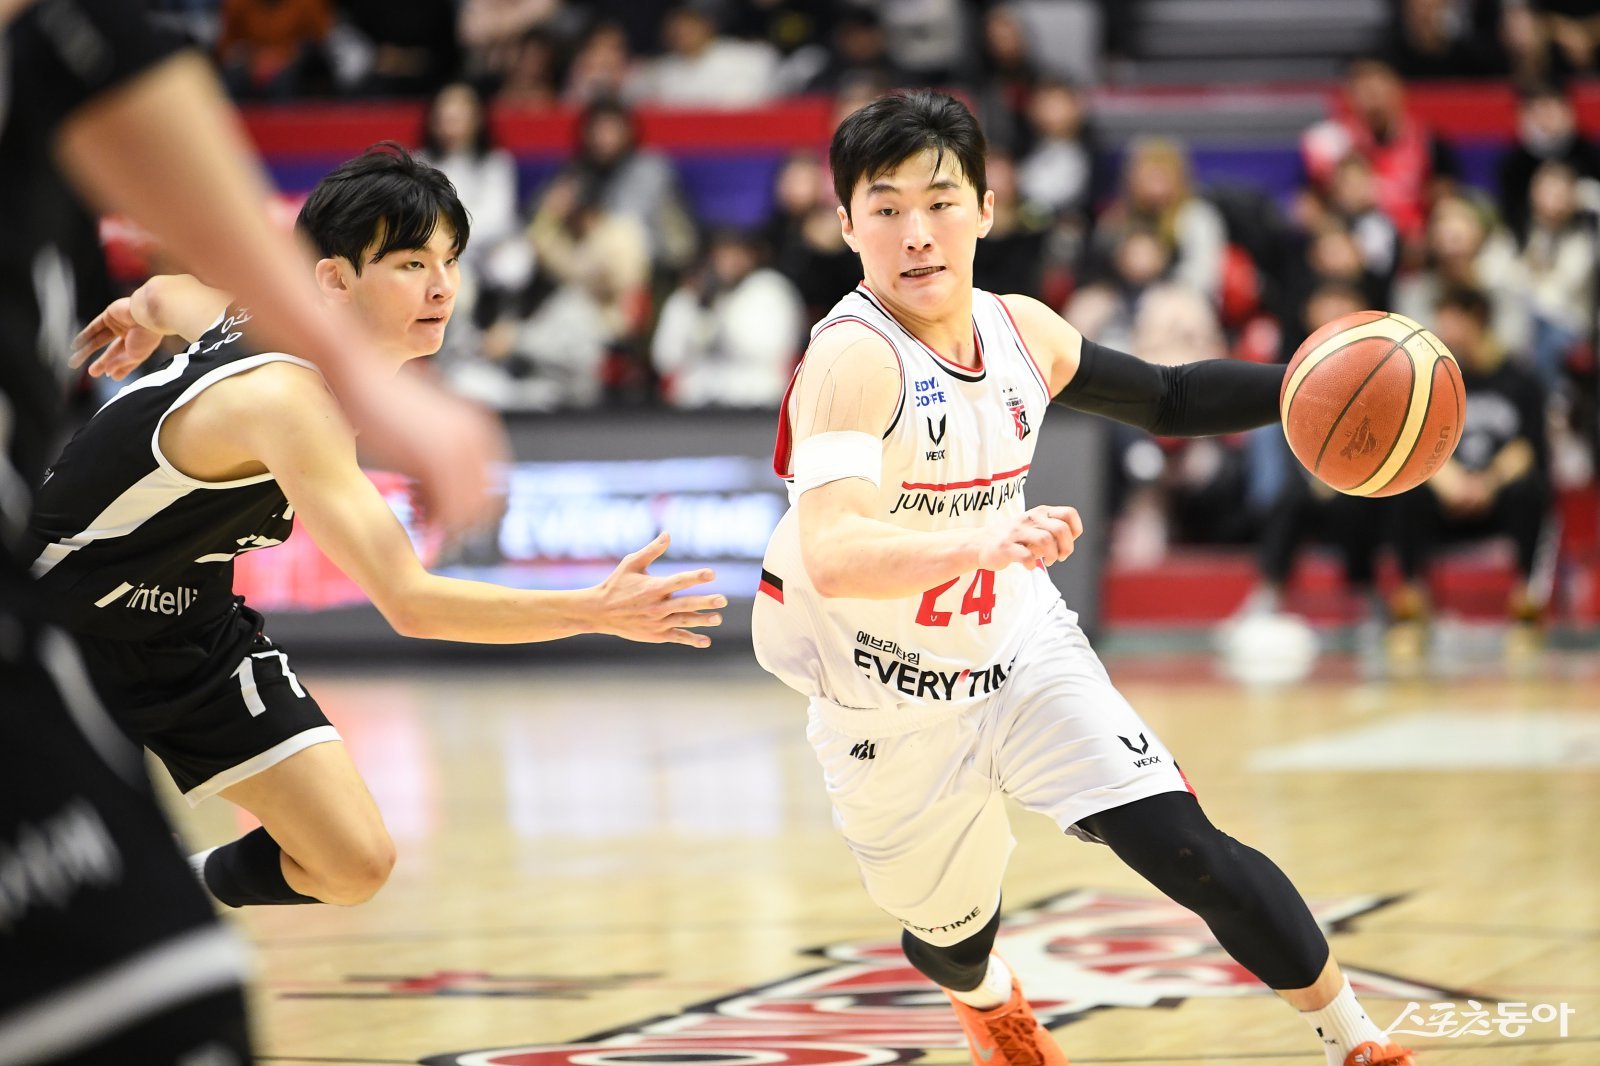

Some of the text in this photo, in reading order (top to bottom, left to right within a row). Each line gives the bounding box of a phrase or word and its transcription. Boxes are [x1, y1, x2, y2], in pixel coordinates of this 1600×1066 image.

[915, 568, 997, 627] 24
[856, 630, 920, 666] 에브리타임
[229, 649, 307, 718] 17
[1132, 755, 1162, 768] VEXX
